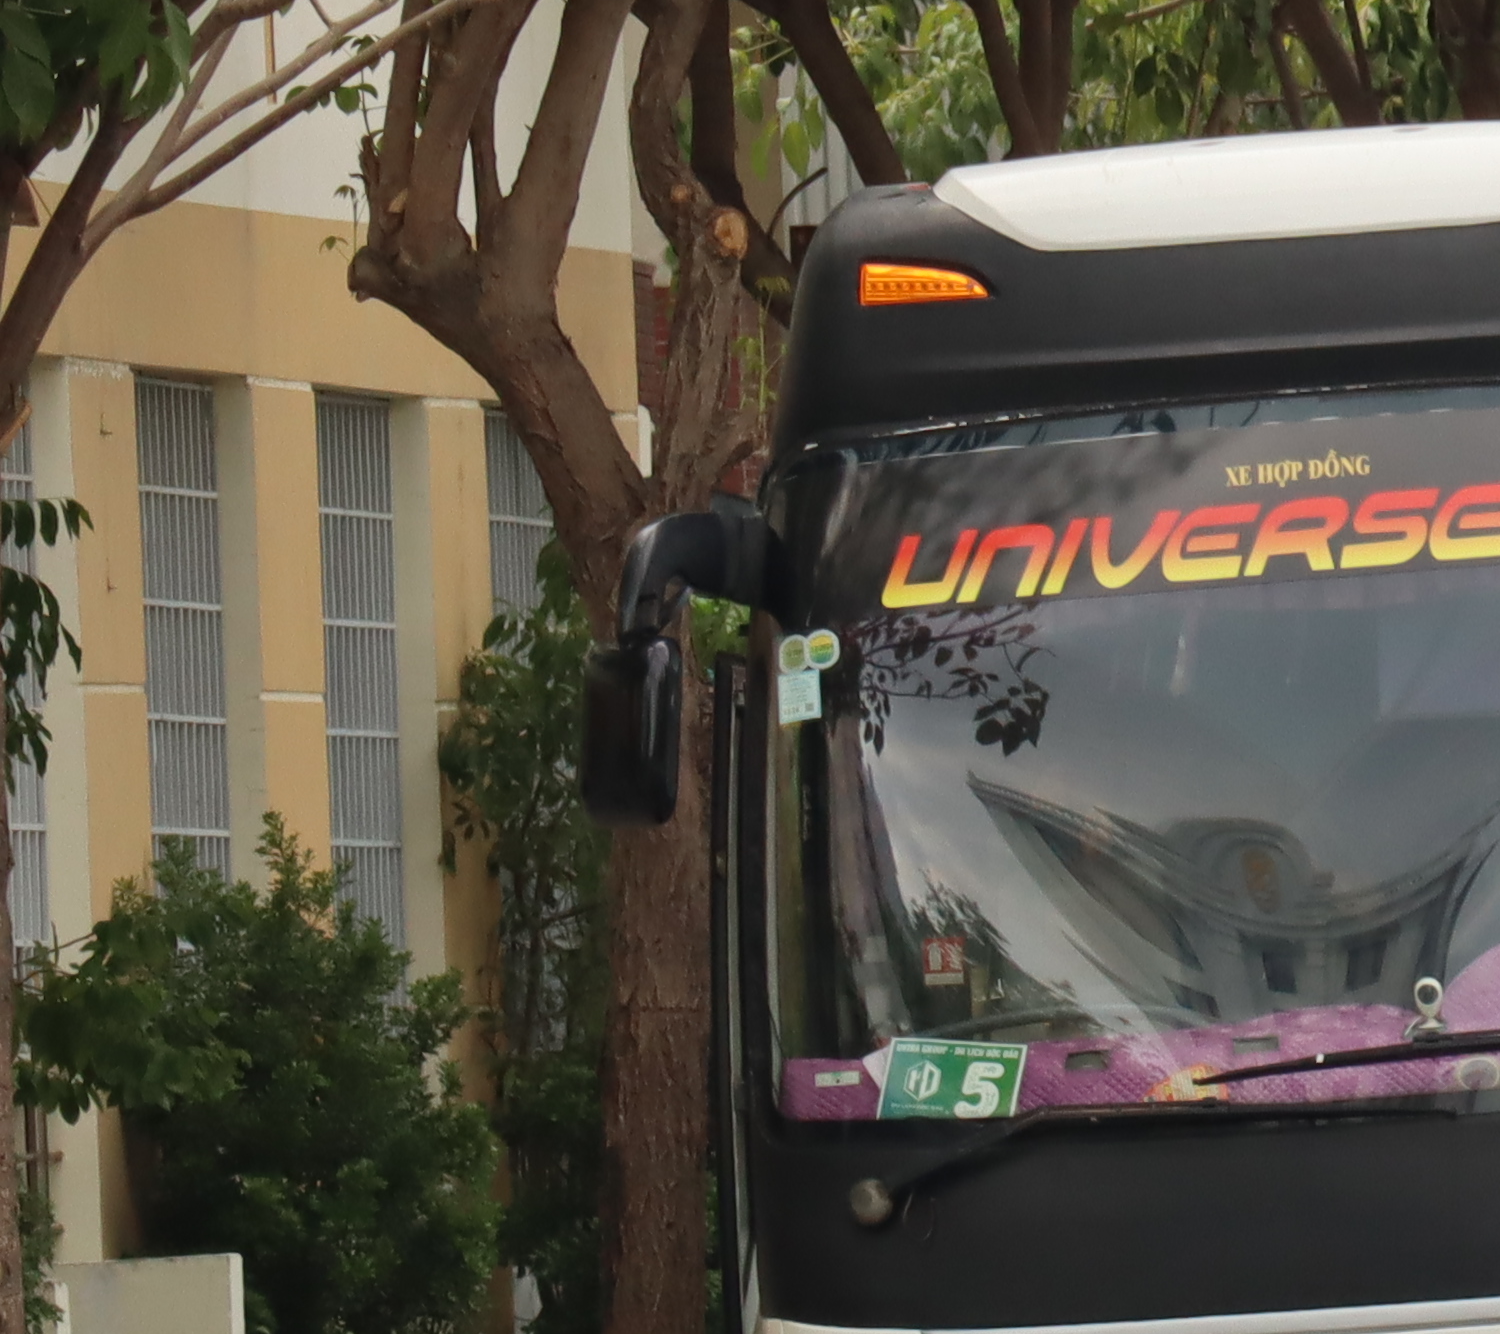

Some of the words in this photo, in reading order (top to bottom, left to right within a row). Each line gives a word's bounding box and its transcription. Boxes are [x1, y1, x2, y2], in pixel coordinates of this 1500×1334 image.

[1225, 466, 1252, 487] XE
[1257, 460, 1303, 488] HỢP
[1309, 449, 1370, 480] ĐỒNG
[954, 1061, 1005, 1119] 5
